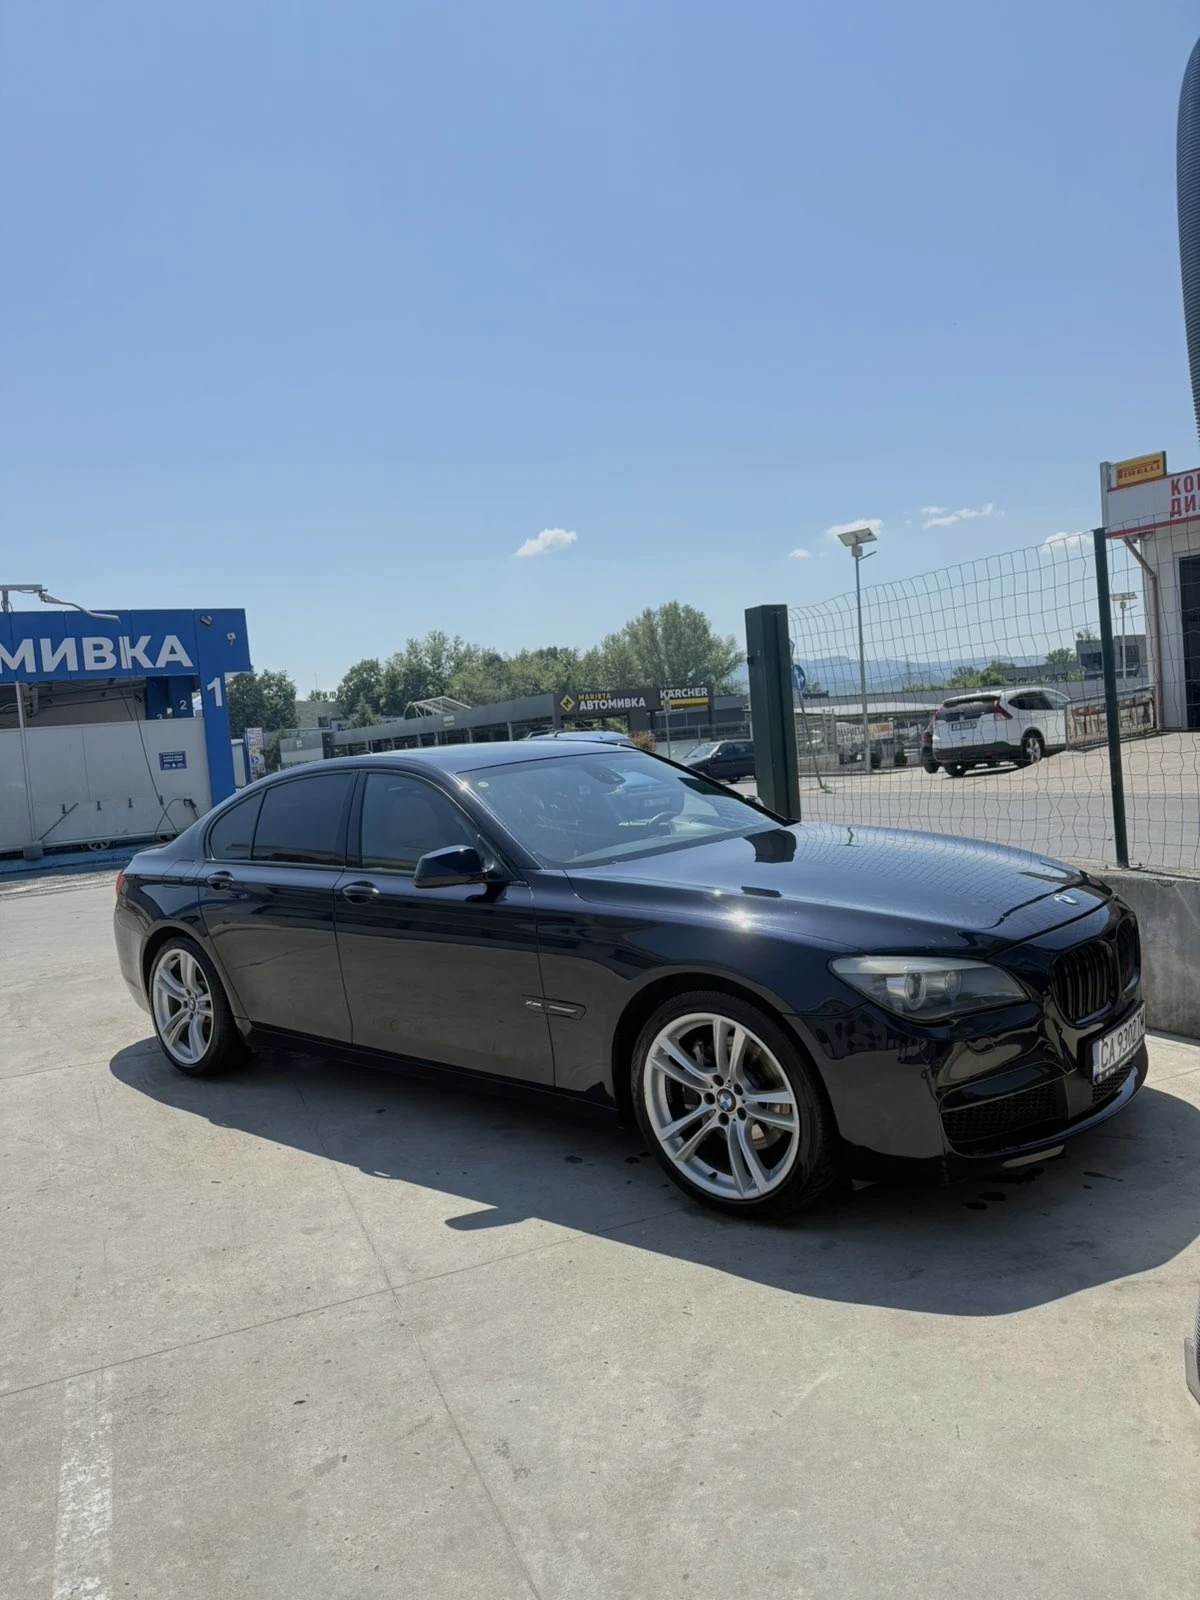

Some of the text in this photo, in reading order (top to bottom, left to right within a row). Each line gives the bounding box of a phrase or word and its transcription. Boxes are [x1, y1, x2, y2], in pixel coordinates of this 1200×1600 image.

[1170, 494, 1200, 518] ДИ
[0, 634, 194, 675] МИВКА
[179, 699, 188, 710] 2
[206, 677, 223, 707] 1
[579, 697, 646, 711] АВТОМИВКА
[1101, 1038, 1115, 1068] CA
